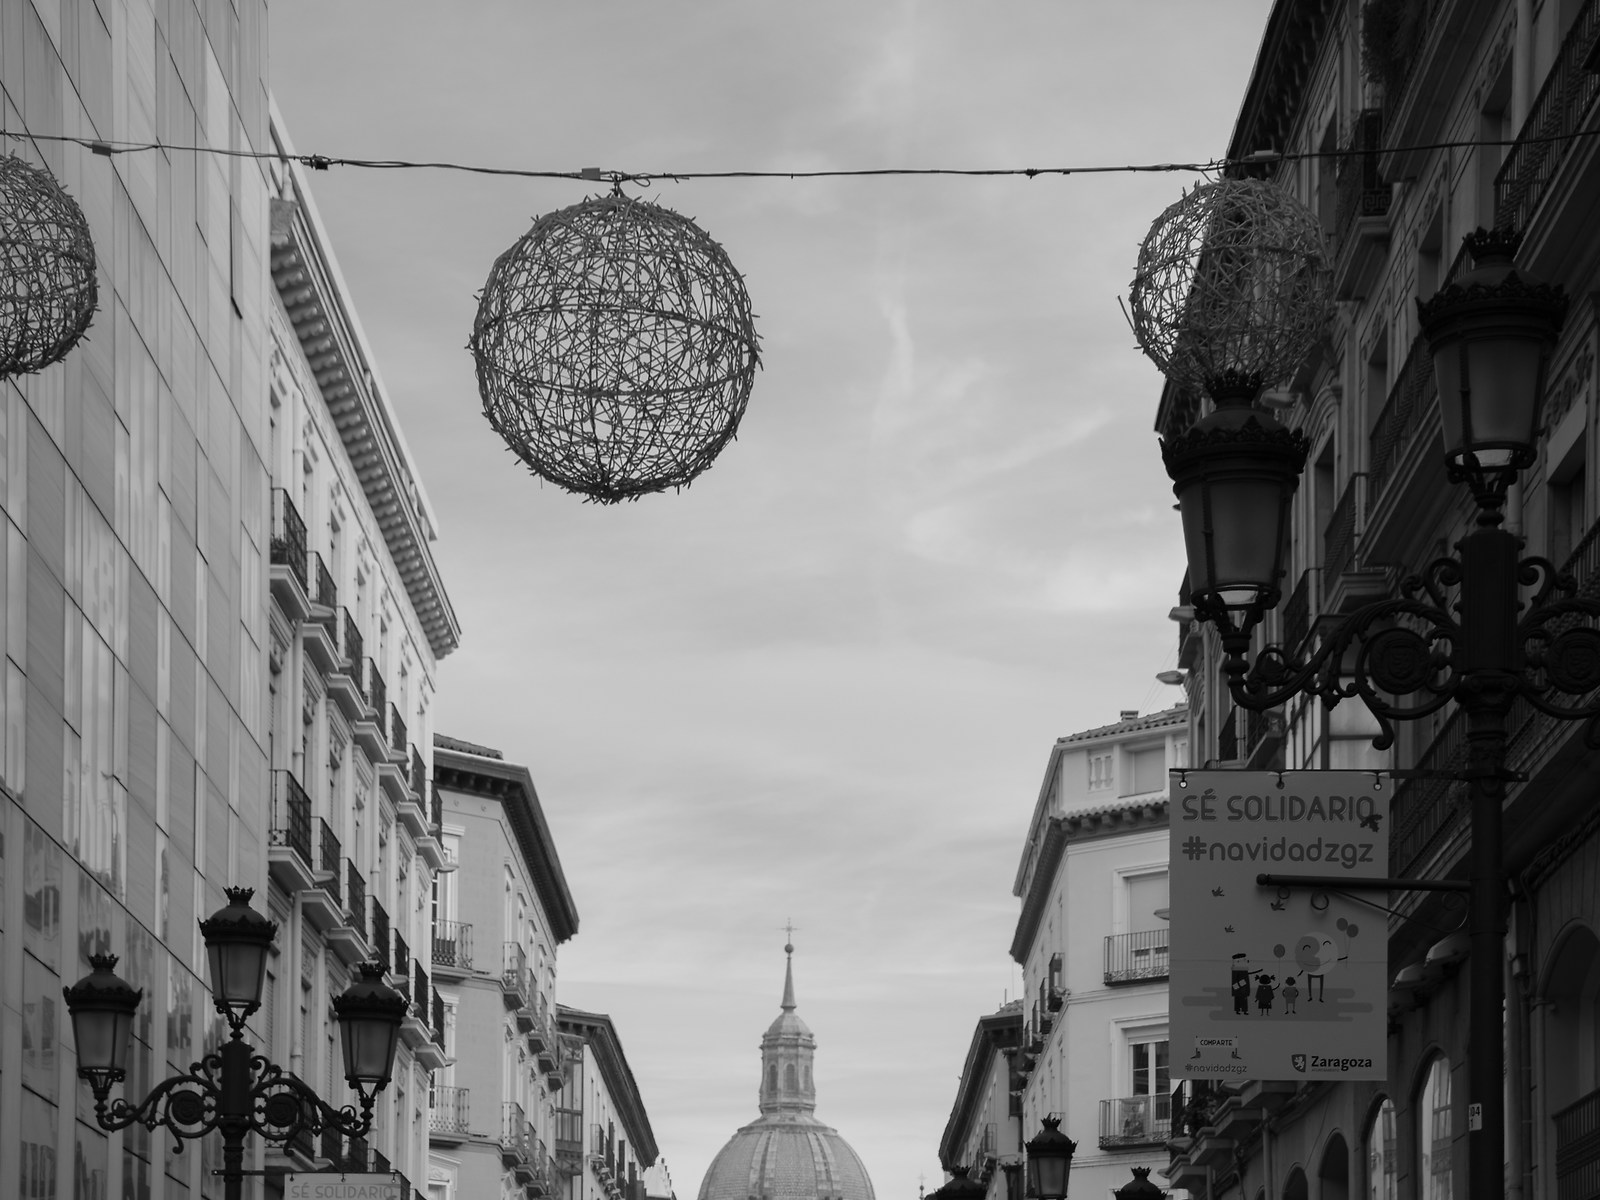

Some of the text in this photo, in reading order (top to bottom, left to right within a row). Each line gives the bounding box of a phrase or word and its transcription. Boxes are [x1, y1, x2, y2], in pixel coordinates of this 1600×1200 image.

[1182, 788, 1375, 822] SÉ SOLIDARIO
[1182, 836, 1373, 869] #navidadzgz
[1311, 1055, 1372, 1072] Zaragoza
[291, 1182, 393, 1199] SÉ SOLIDARIO
